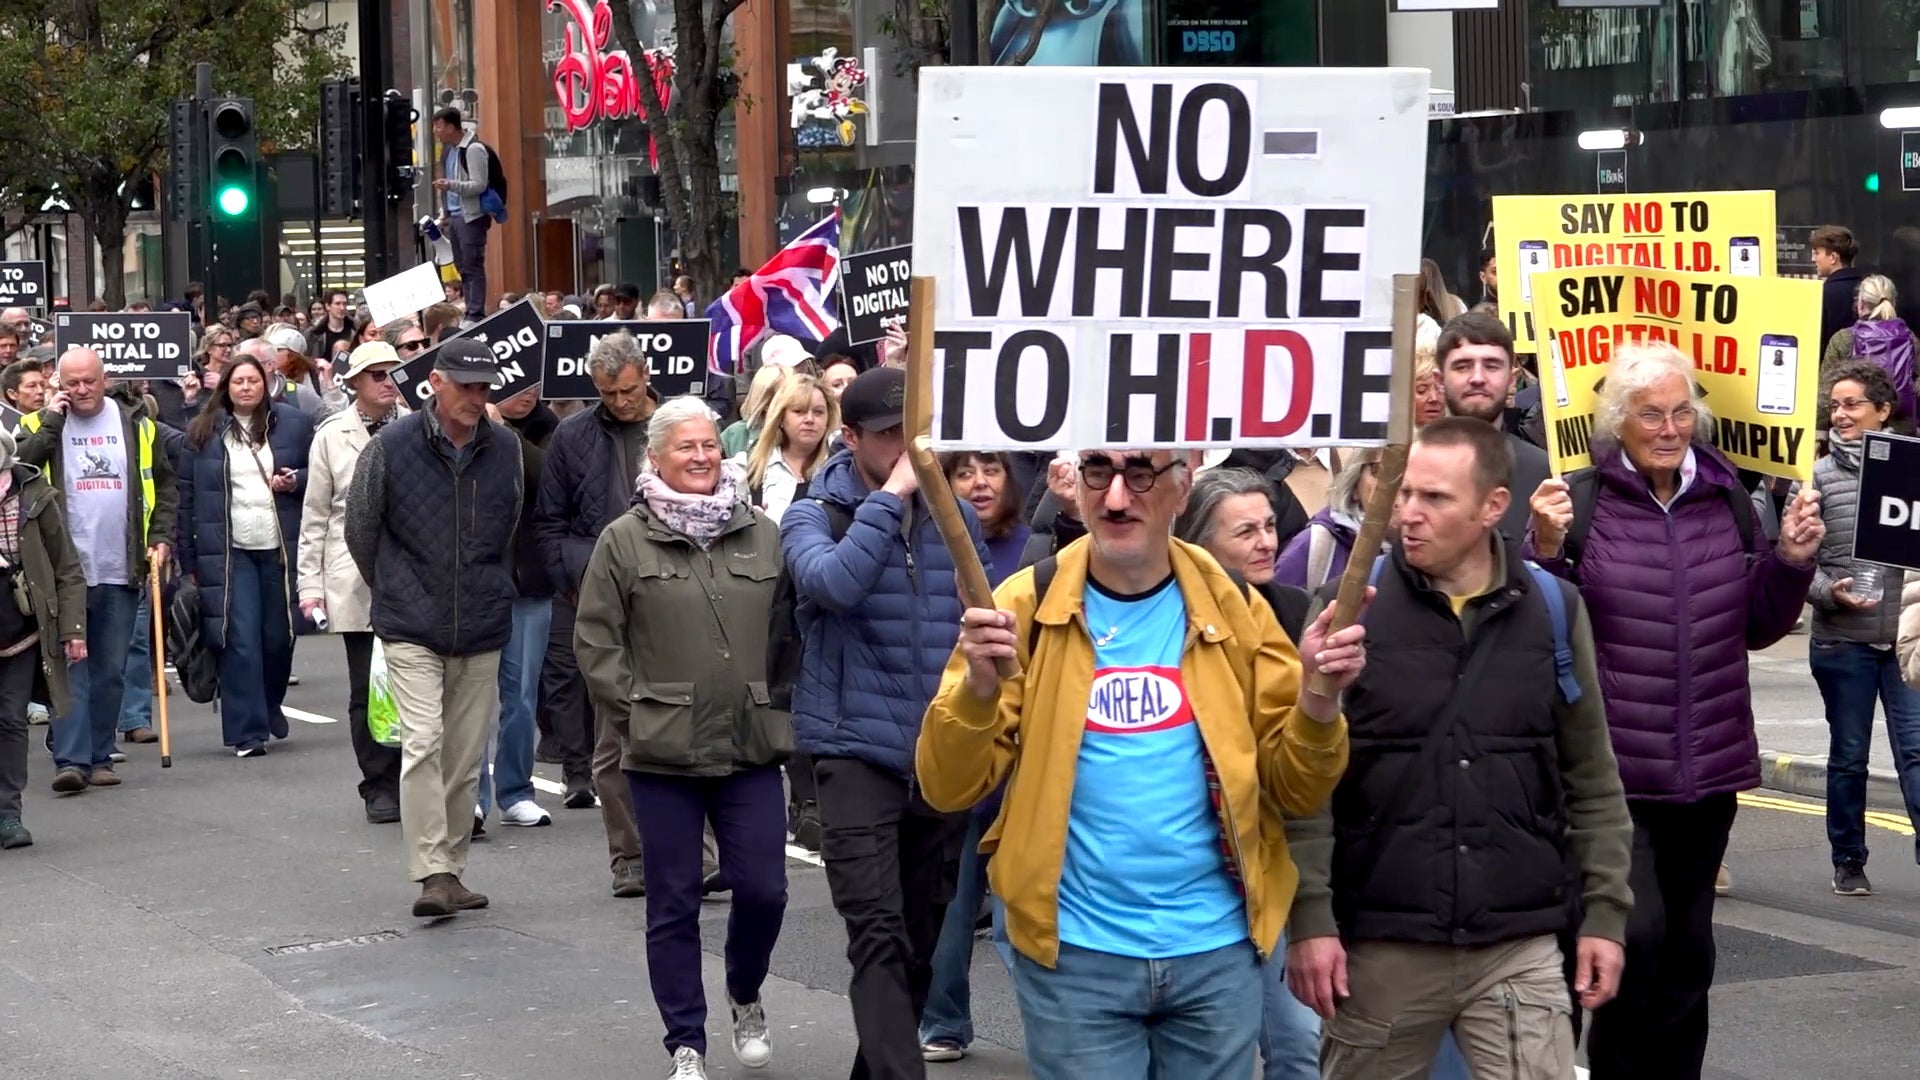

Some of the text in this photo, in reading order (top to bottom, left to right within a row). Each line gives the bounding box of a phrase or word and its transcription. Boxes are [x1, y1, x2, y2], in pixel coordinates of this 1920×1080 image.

[1606, 167, 1624, 184] Bovis
[1560, 200, 1709, 235] SAY NO TO
[957, 206, 1366, 319] WHERE
[1553, 241, 1720, 272] DIGITAL I.D.
[2, 268, 24, 281] TO
[865, 259, 910, 287] NO TO
[21, 281, 38, 294] ID
[852, 286, 910, 317] DIGITAL
[1558, 275, 1738, 324] SAY NO TO
[92, 322, 161, 340] NO TO
[637, 333, 673, 352] TO
[157, 342, 180, 359] ID
[1692, 332, 1747, 377] I.D.
[667, 356, 695, 375] ID
[934, 329, 1071, 443] TO
[71, 435, 118, 446] SAY NO TO
[76, 480, 123, 491] DIGITAL ID
[1088, 676, 1169, 724] UNREAL
